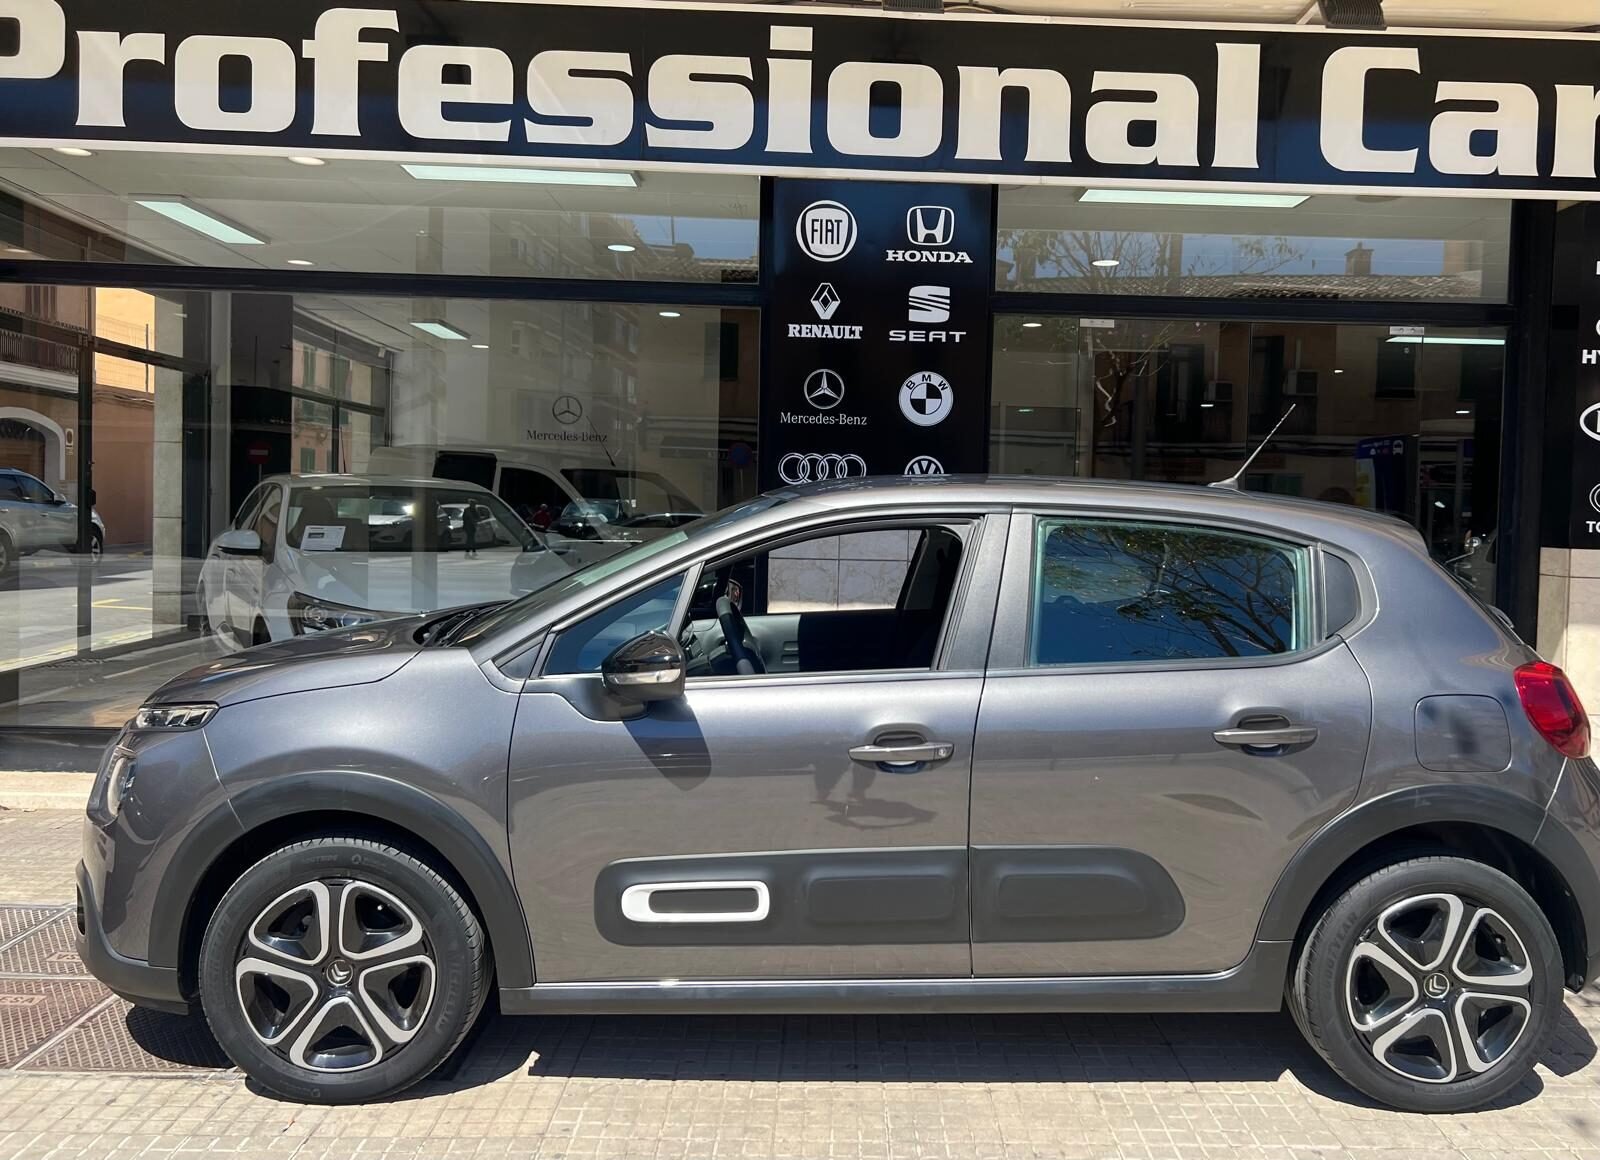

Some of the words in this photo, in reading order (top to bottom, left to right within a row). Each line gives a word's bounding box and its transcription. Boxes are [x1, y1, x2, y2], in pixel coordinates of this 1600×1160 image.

[811, 218, 843, 245] FIAT
[886, 249, 973, 263] HONDA
[787, 323, 863, 340] RENAULT
[889, 330, 967, 343] SEAT
[905, 374, 949, 391] BMW
[780, 411, 868, 426] Mercedes-Benz
[526, 430, 608, 442] Mercedes-Benz
